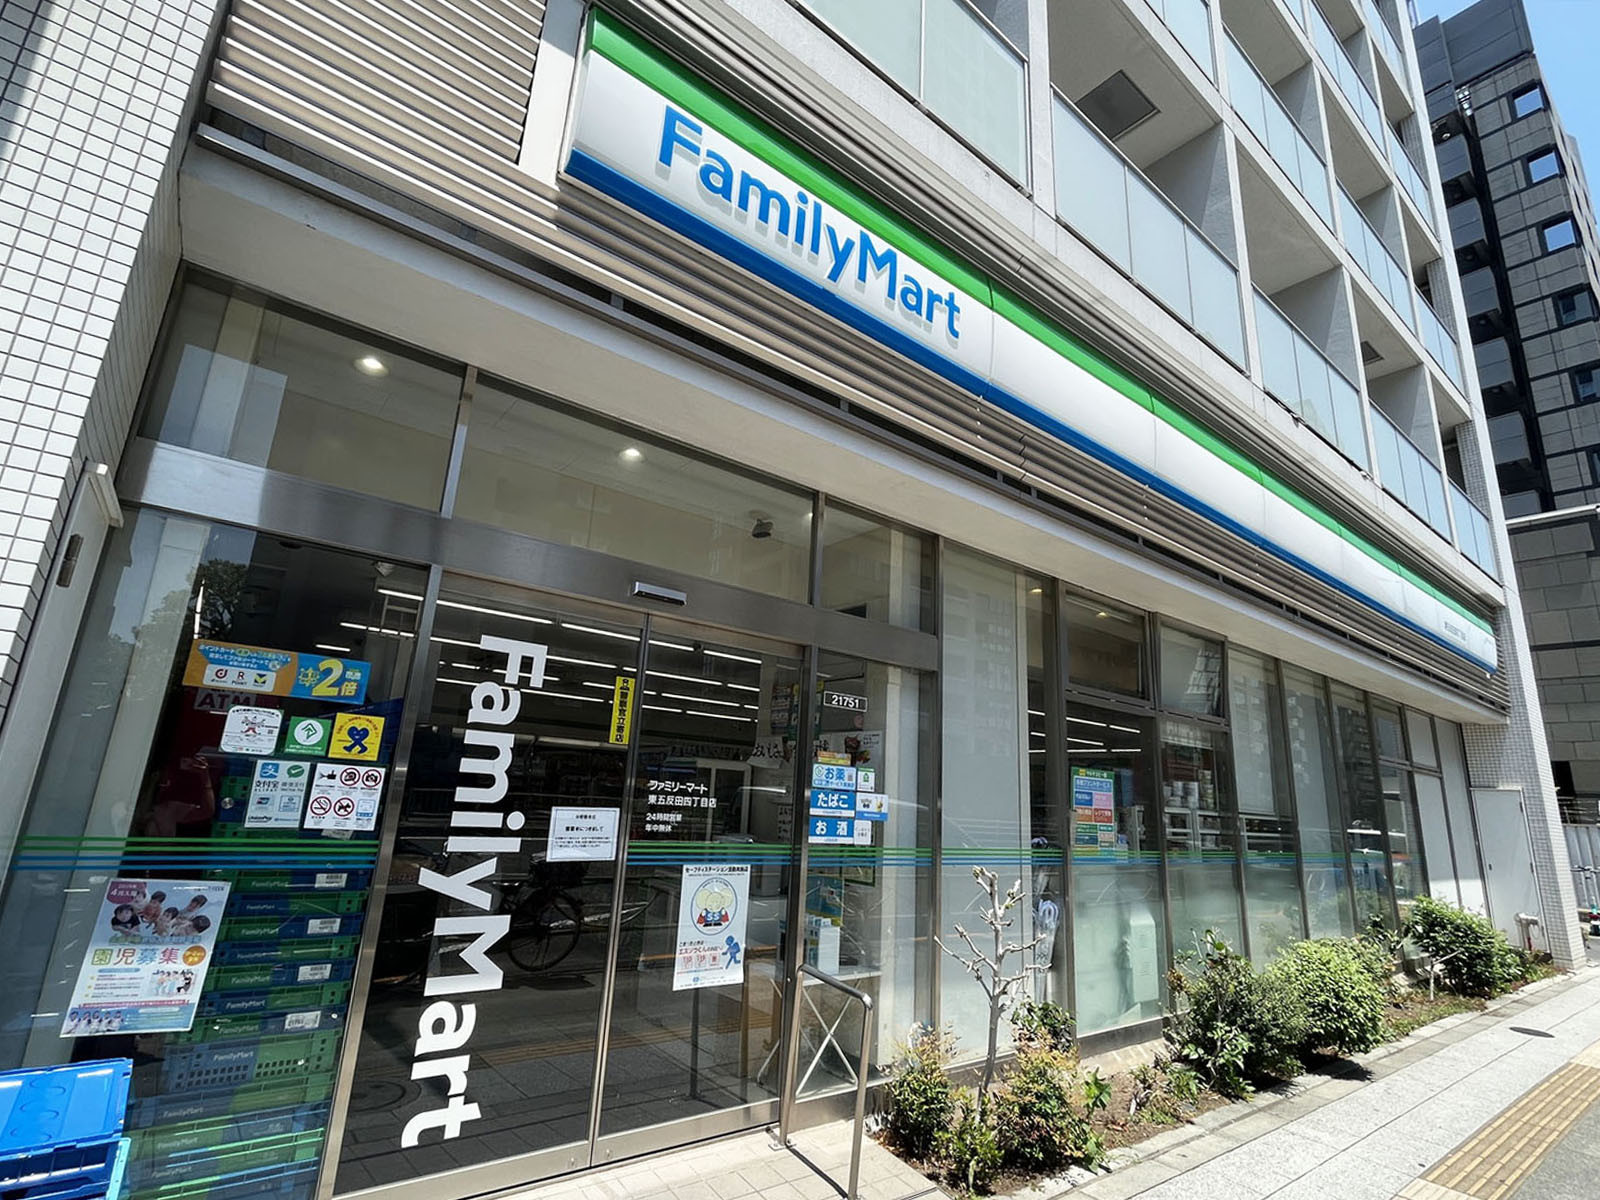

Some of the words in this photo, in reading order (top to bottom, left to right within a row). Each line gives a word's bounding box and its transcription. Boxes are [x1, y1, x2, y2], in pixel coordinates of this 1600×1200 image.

[658, 104, 961, 339] FamilyMart
[198, 691, 251, 709] ATM
[832, 695, 859, 708] 21751
[649, 780, 708, 794] ファミリーマート
[648, 794, 717, 809] 東五反田四丁目店
[817, 792, 848, 808] たばこ
[646, 812, 682, 822] 24時間営業
[401, 634, 549, 1148] FamilyMart
[91, 947, 180, 966] 園児募集
